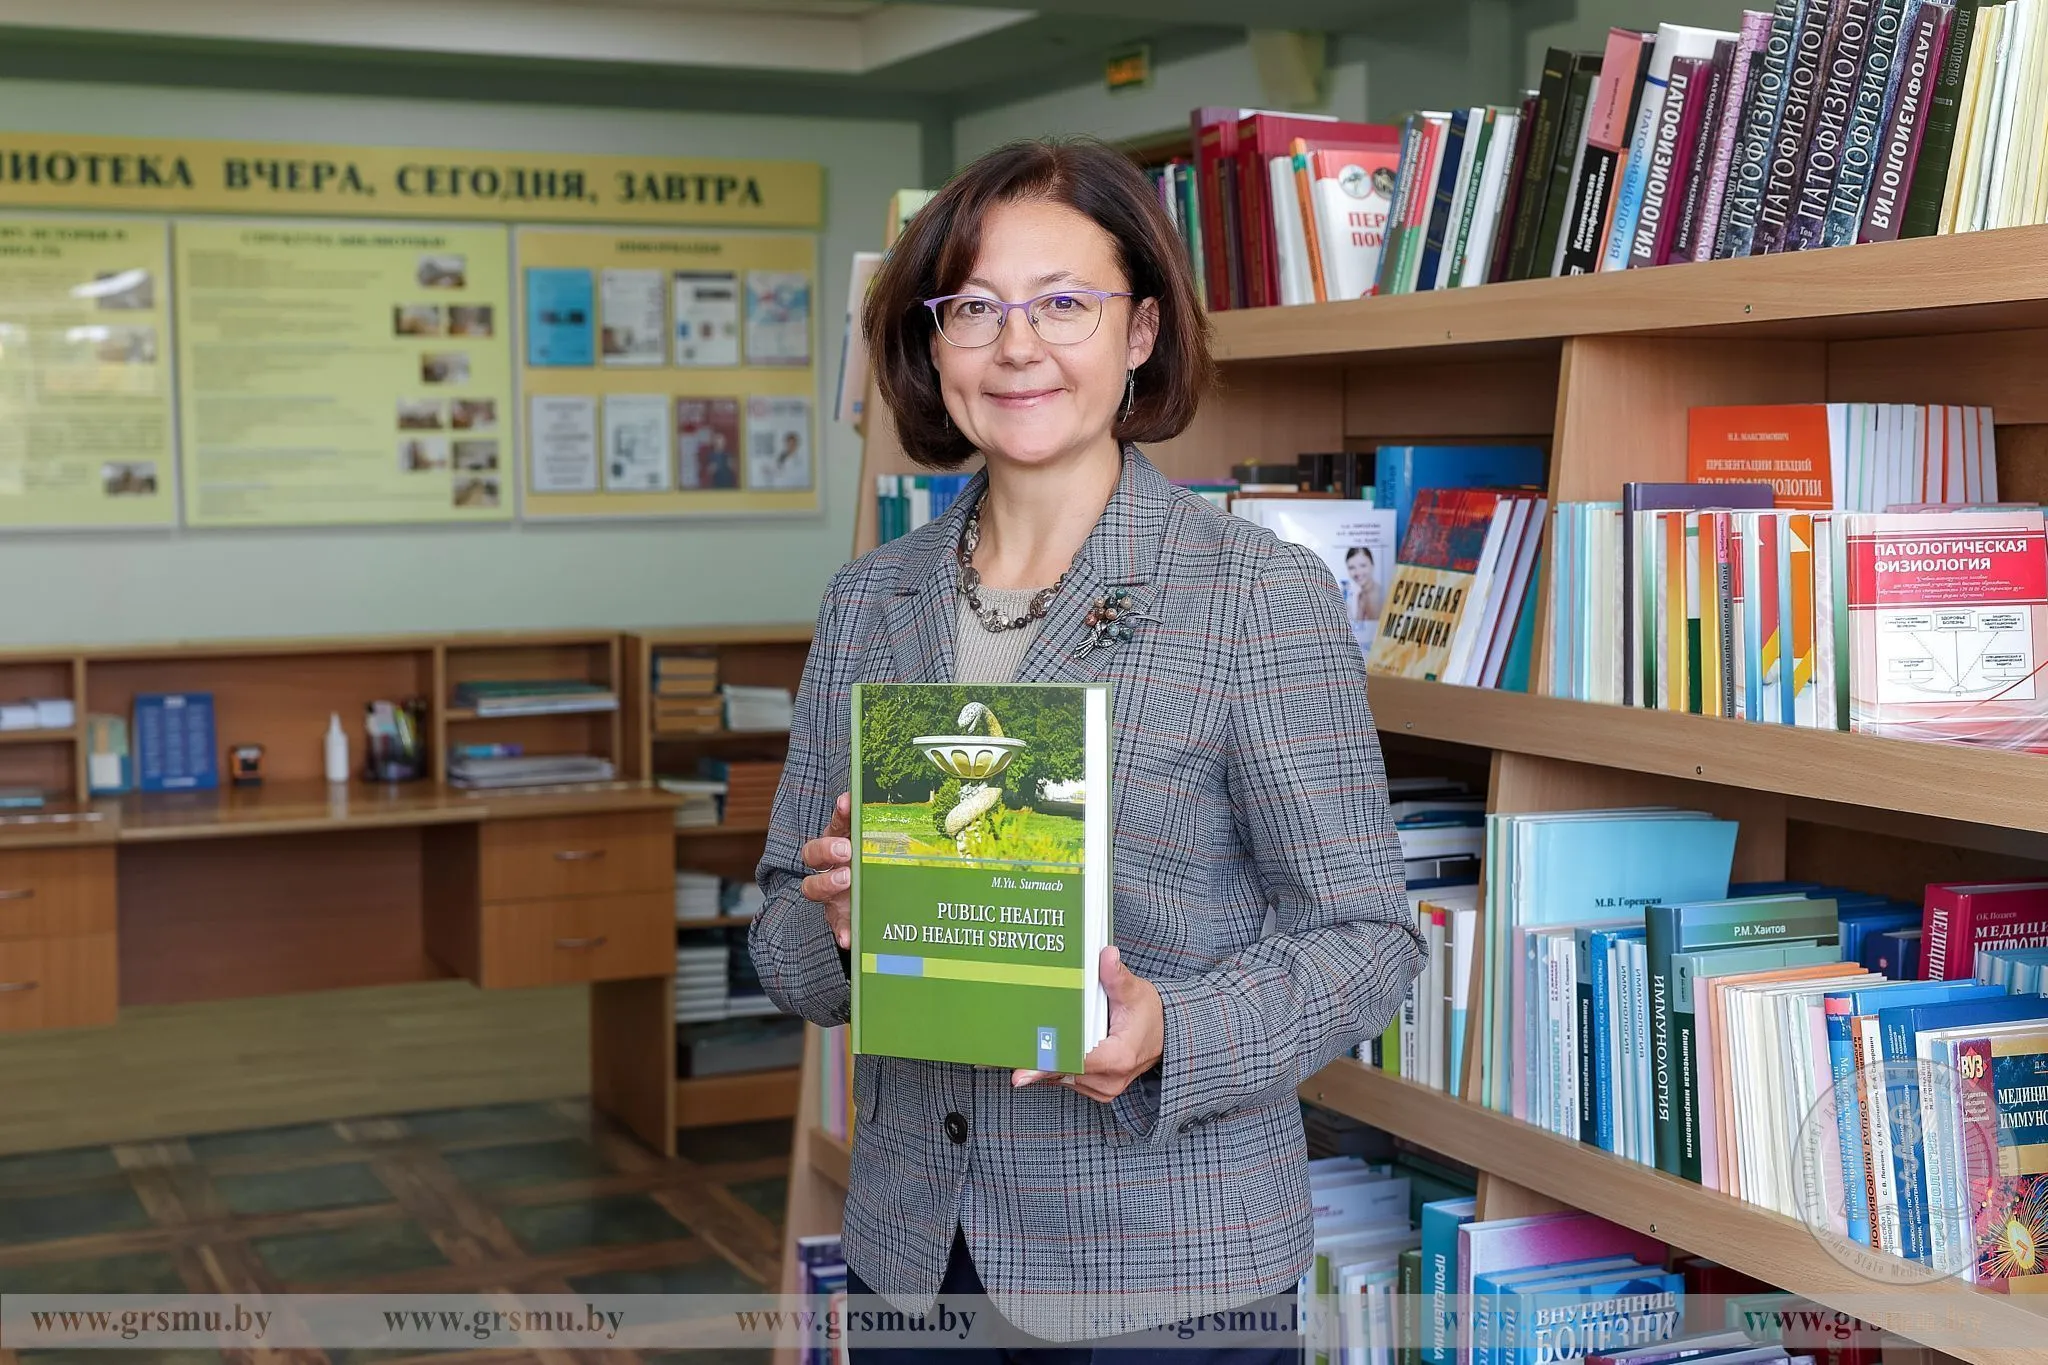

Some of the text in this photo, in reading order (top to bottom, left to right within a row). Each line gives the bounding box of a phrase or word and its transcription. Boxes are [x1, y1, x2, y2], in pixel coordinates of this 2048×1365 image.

[1945, 9, 1972, 87] ФИЗИОЛОГИЯ
[1870, 21, 1934, 230] ПАТОФИЗИОЛОГИЯ
[0, 150, 765, 208] ИОТЕКА ВЧЕРА, СЕГОДНЯ, ЗАВТРА
[1610, 107, 1654, 260] ПАТОФИЗИОЛОГИЯ
[1633, 73, 1688, 259] ПАТОФИЗИОЛОГИЯ
[1678, 72, 1721, 250] ПАТОЛОГИЧЕСКАЯ ФИЗИОЛОГИЯ
[1572, 173, 1597, 250] Клиническая
[1583, 155, 1610, 252] патофизиология
[1773, 458, 1813, 473] ЛЕКЦИЙ
[1874, 539, 2028, 557] ПАТОЛОГИЧЕСКАЯ
[1874, 557, 1991, 573] ФИЗИОЛОГИЯ
[1393, 579, 1463, 614] СУДЕБНАЯ
[1720, 564, 1730, 591] Атлас
[1383, 611, 1452, 648] МЕДИЦИНА
[937, 902, 1065, 927] PUBLIC HEALTH
[1618, 896, 1663, 908] Горецкая
[883, 923, 1065, 952] AND HEALTH SERVICES
[1733, 924, 1786, 937] Р.М. Хаитов
[1621, 965, 1630, 1055] ИММУНОЛОГИЯ
[1635, 968, 1645, 1058] ИММУНОЛОГИЯ
[1653, 974, 1670, 1122] ИММУНОЛОГИЯ
[1961, 1054, 1984, 1079] ВУЗ
[1681, 1028, 1693, 1159] Клиническая микробиология
[1859, 1100, 1869, 1147] ОБЩАЯ
[1433, 1253, 1446, 1360] ПРОПЕДЕВТИКА
[1536, 1290, 1677, 1328] ВНУТРЕННИЕ
[1534, 1310, 1678, 1365] БОЛЕЗНИ
